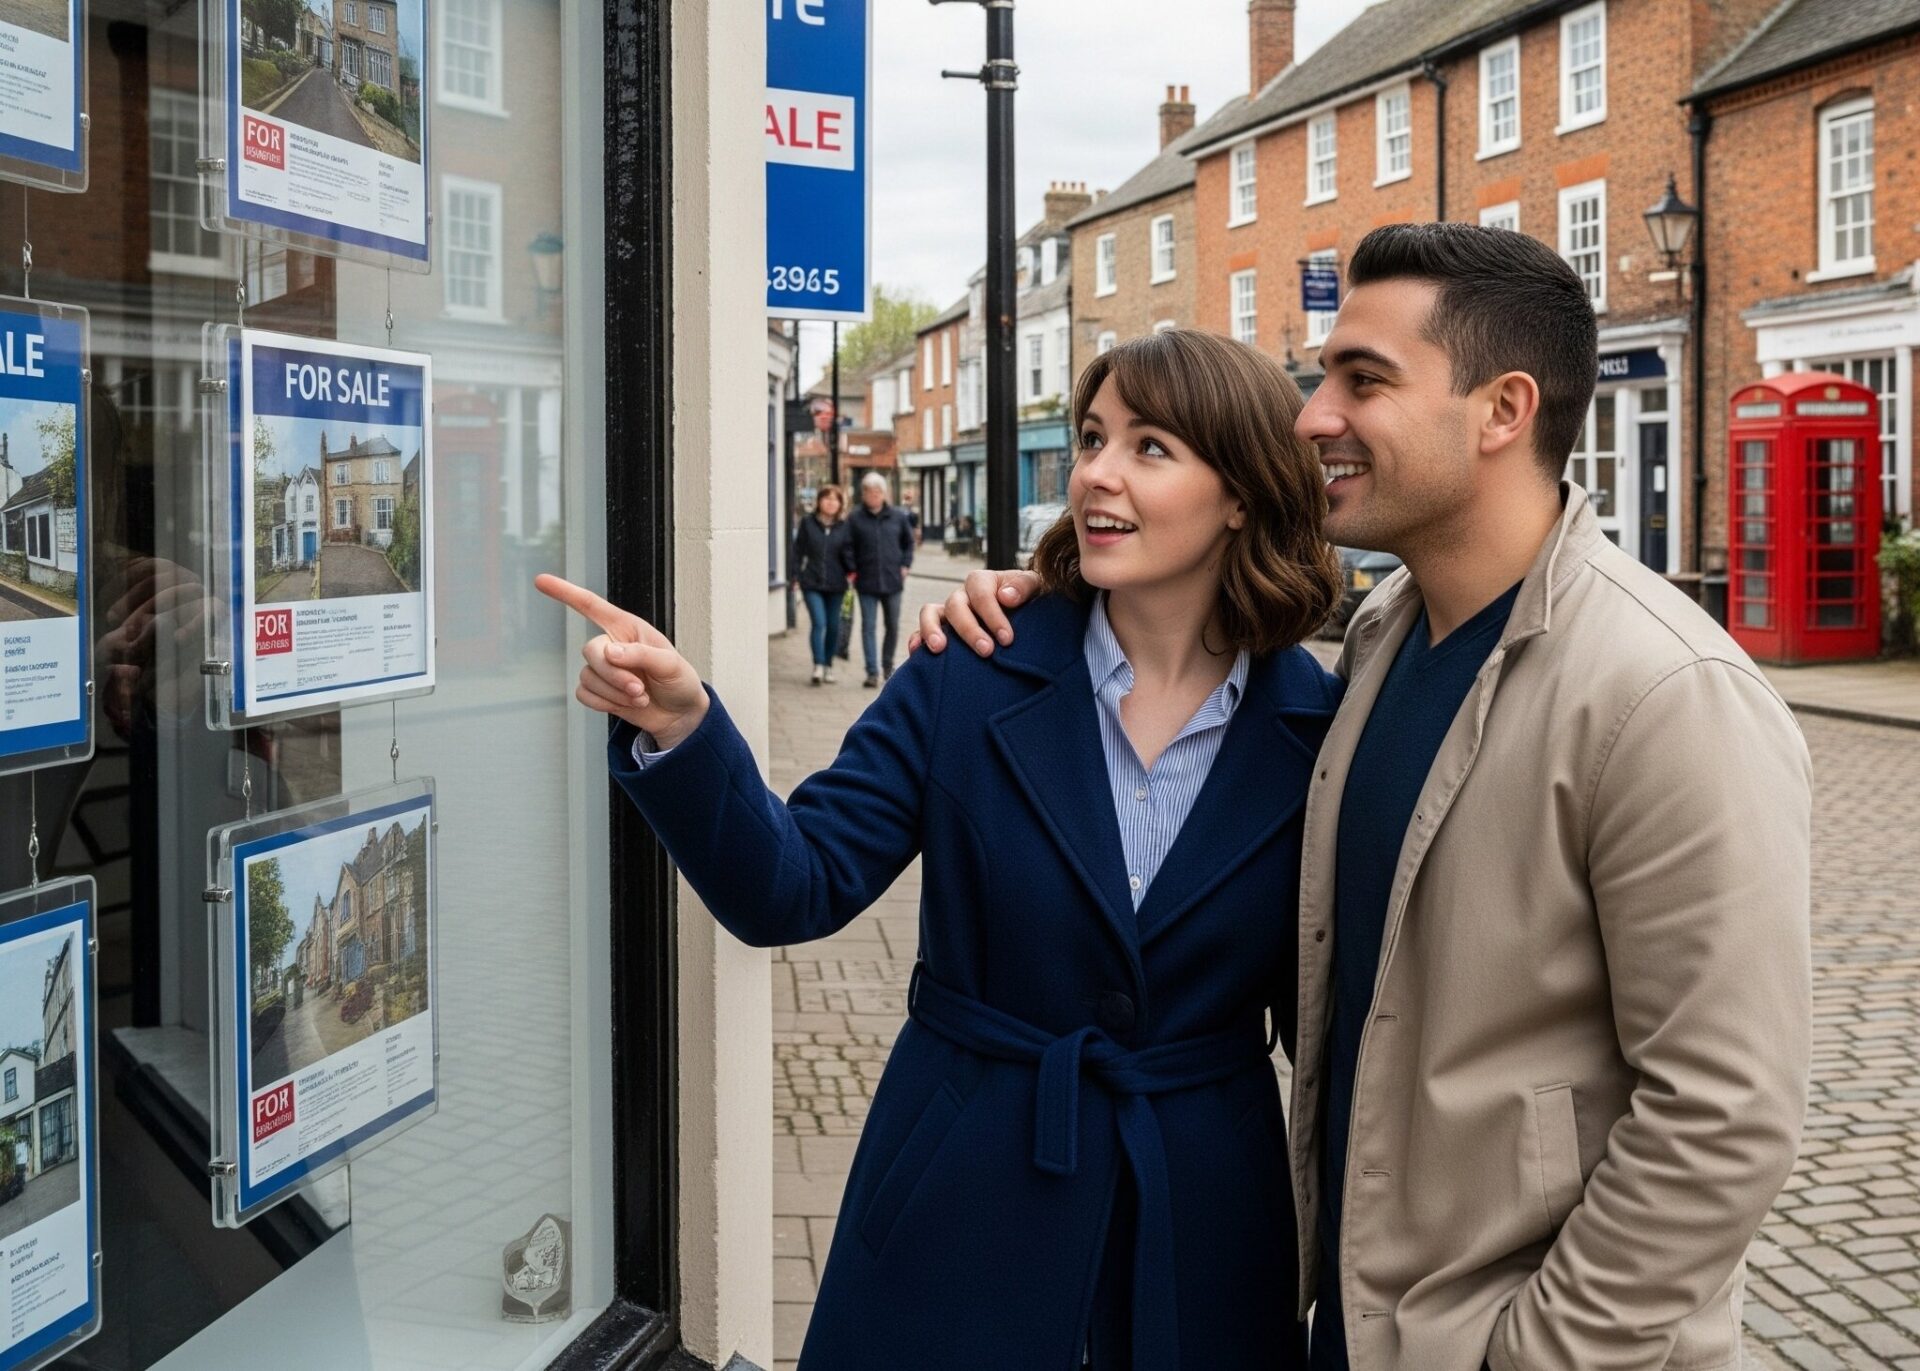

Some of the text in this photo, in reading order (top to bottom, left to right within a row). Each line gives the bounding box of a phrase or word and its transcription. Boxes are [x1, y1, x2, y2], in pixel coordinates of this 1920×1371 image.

[247, 120, 281, 151] FOR
[766, 104, 842, 152] ALE
[0, 331, 45, 378] LE
[285, 362, 390, 407] FOR SALE
[256, 613, 288, 638] FOR
[256, 1087, 289, 1123] FOR
